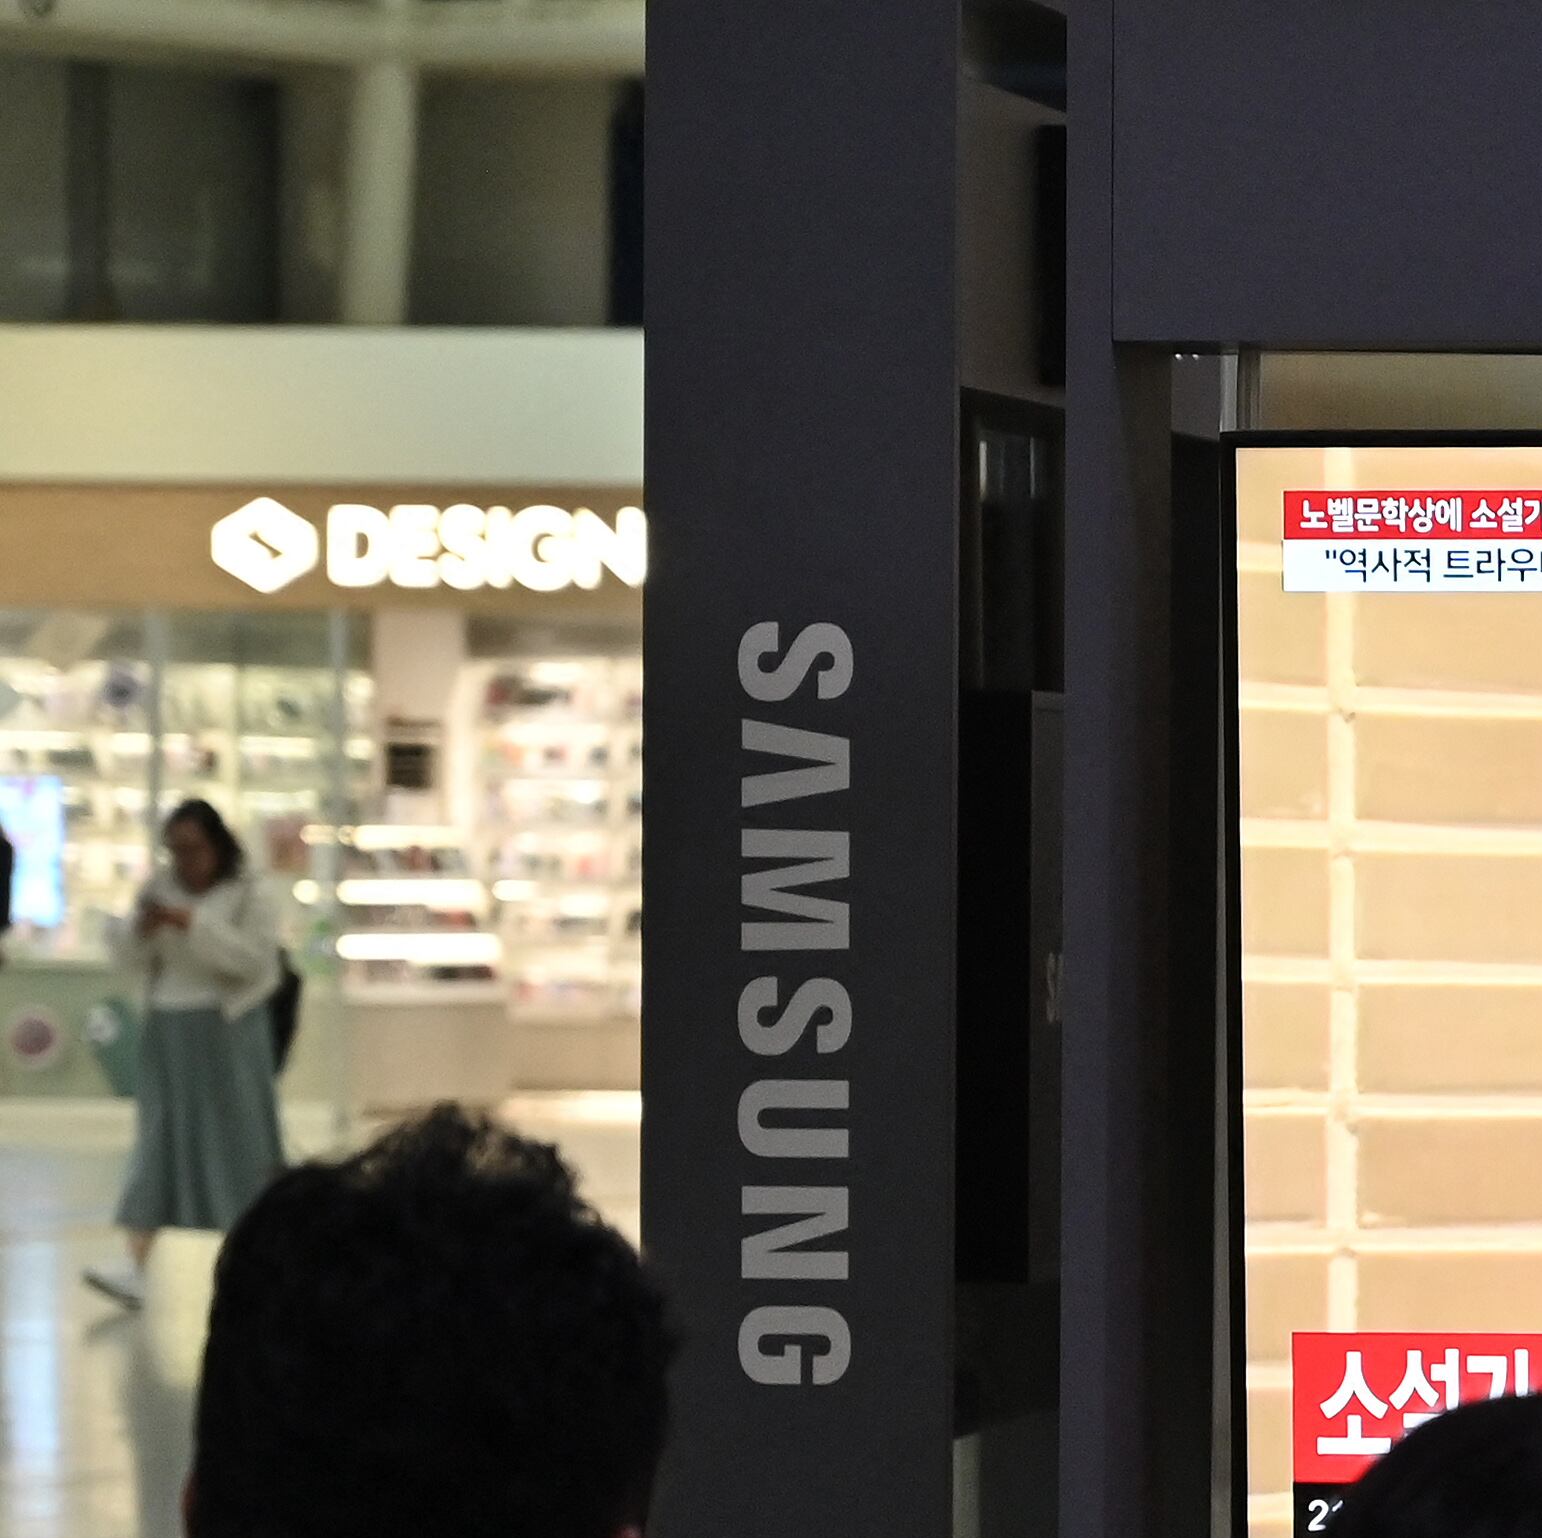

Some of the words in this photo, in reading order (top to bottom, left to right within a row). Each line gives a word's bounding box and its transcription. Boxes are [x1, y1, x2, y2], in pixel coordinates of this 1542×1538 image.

[1300, 497, 1463, 533] 노벨문학상에
[327, 503, 647, 592] DESIGN
[1325, 547, 1430, 583] "역사적
[737, 621, 854, 1385] SAMSUNG
